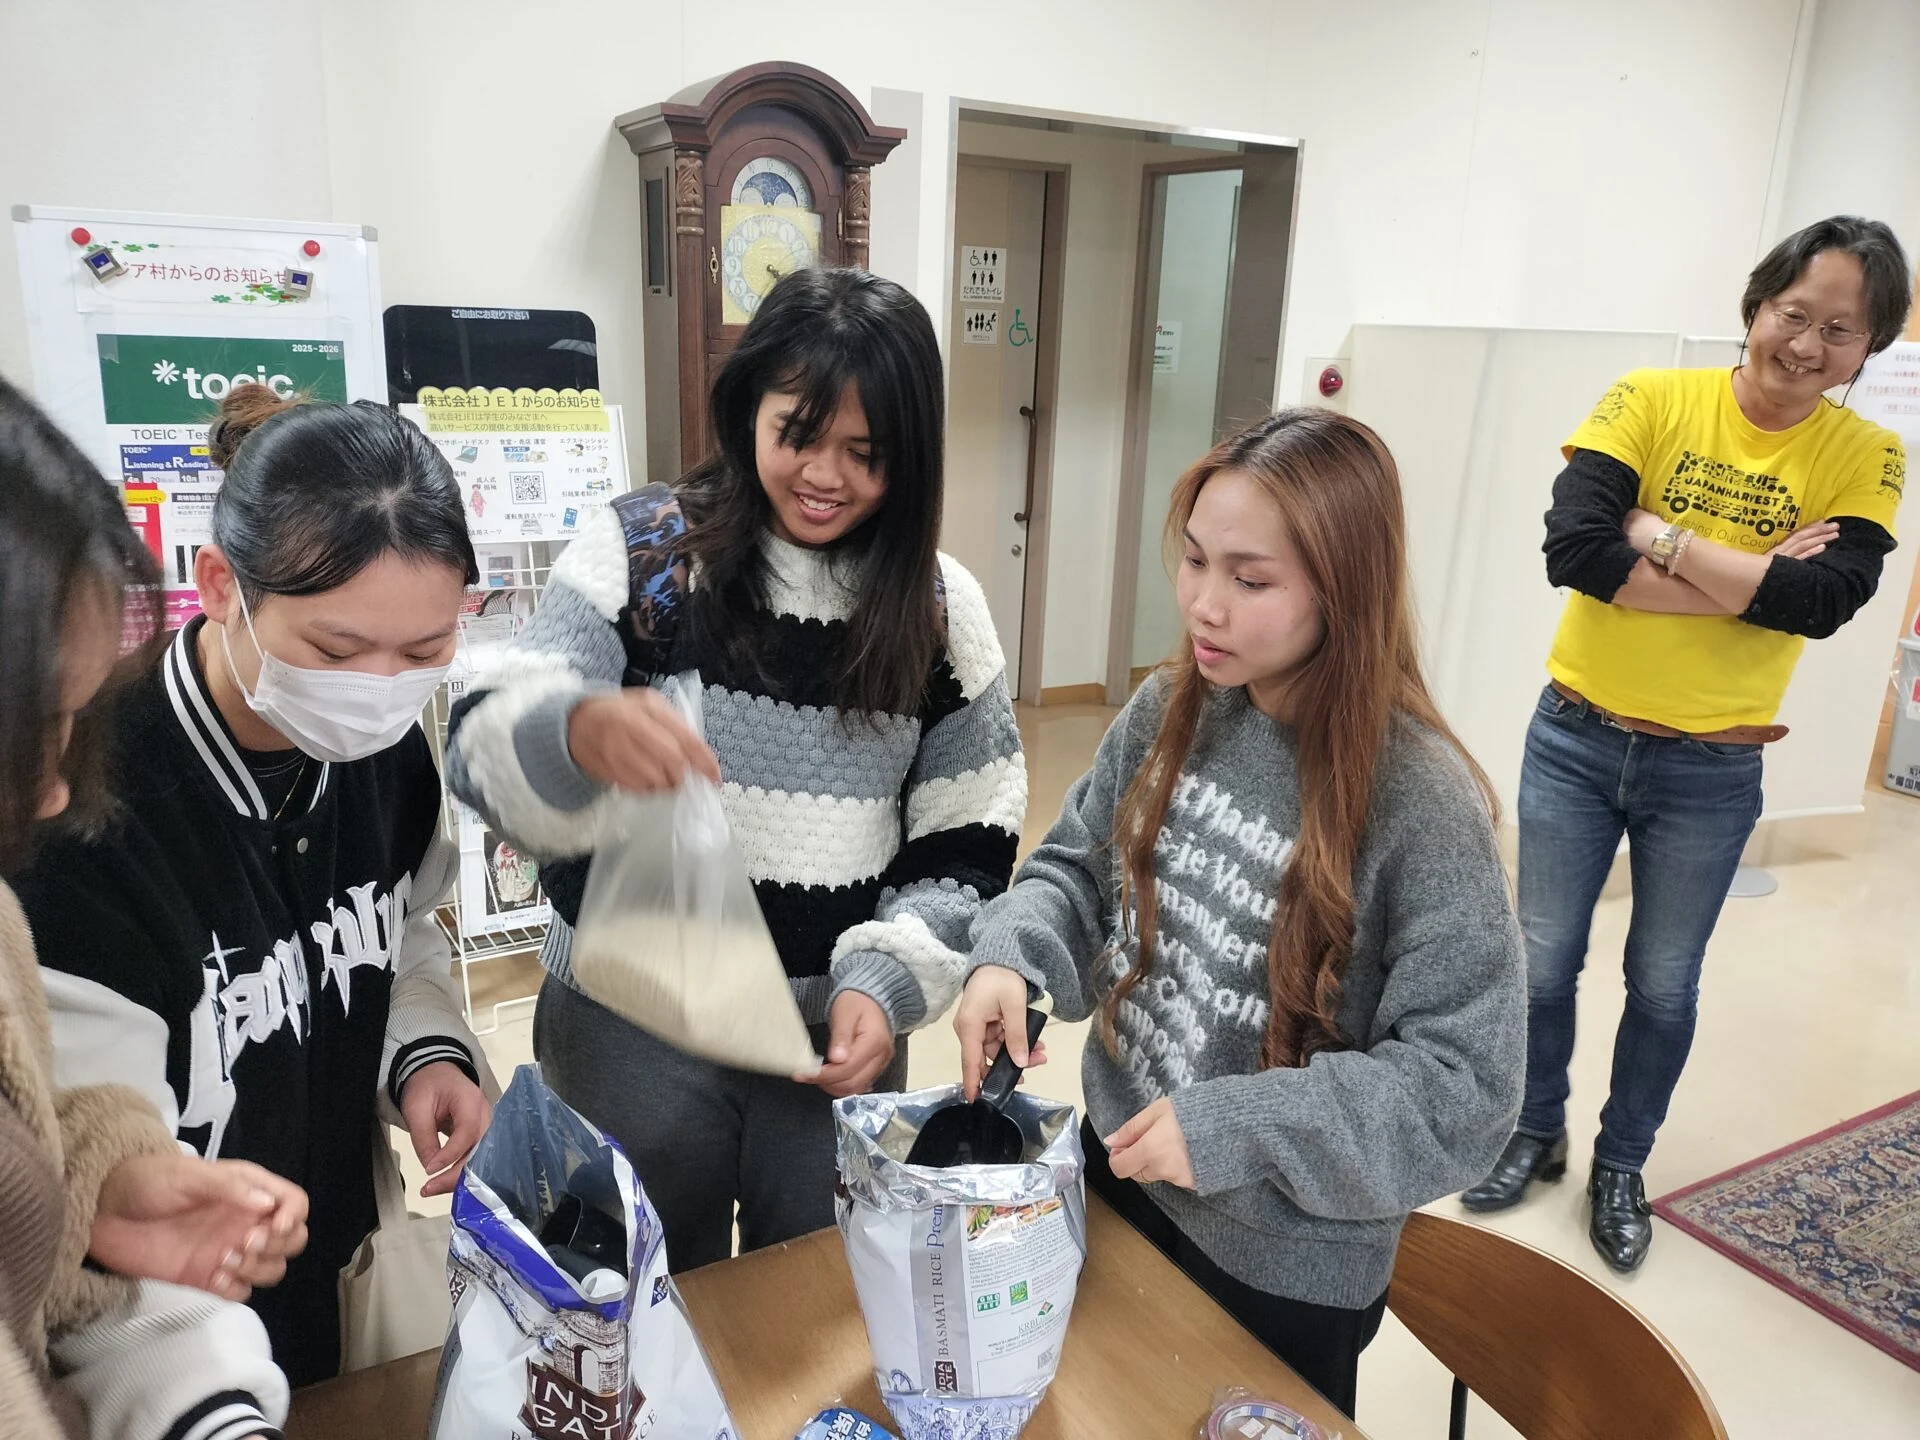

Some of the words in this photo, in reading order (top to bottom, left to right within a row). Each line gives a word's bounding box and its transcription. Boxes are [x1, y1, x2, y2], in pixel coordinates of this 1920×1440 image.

[963, 286, 1002, 296] だれでもトイレ
[451, 309, 530, 320] ご自由にお取り下さい
[124, 457, 164, 469] Listening
[172, 456, 208, 469] Reading
[930, 1253, 943, 1287] RICE
[933, 1293, 950, 1357] BASMATI
